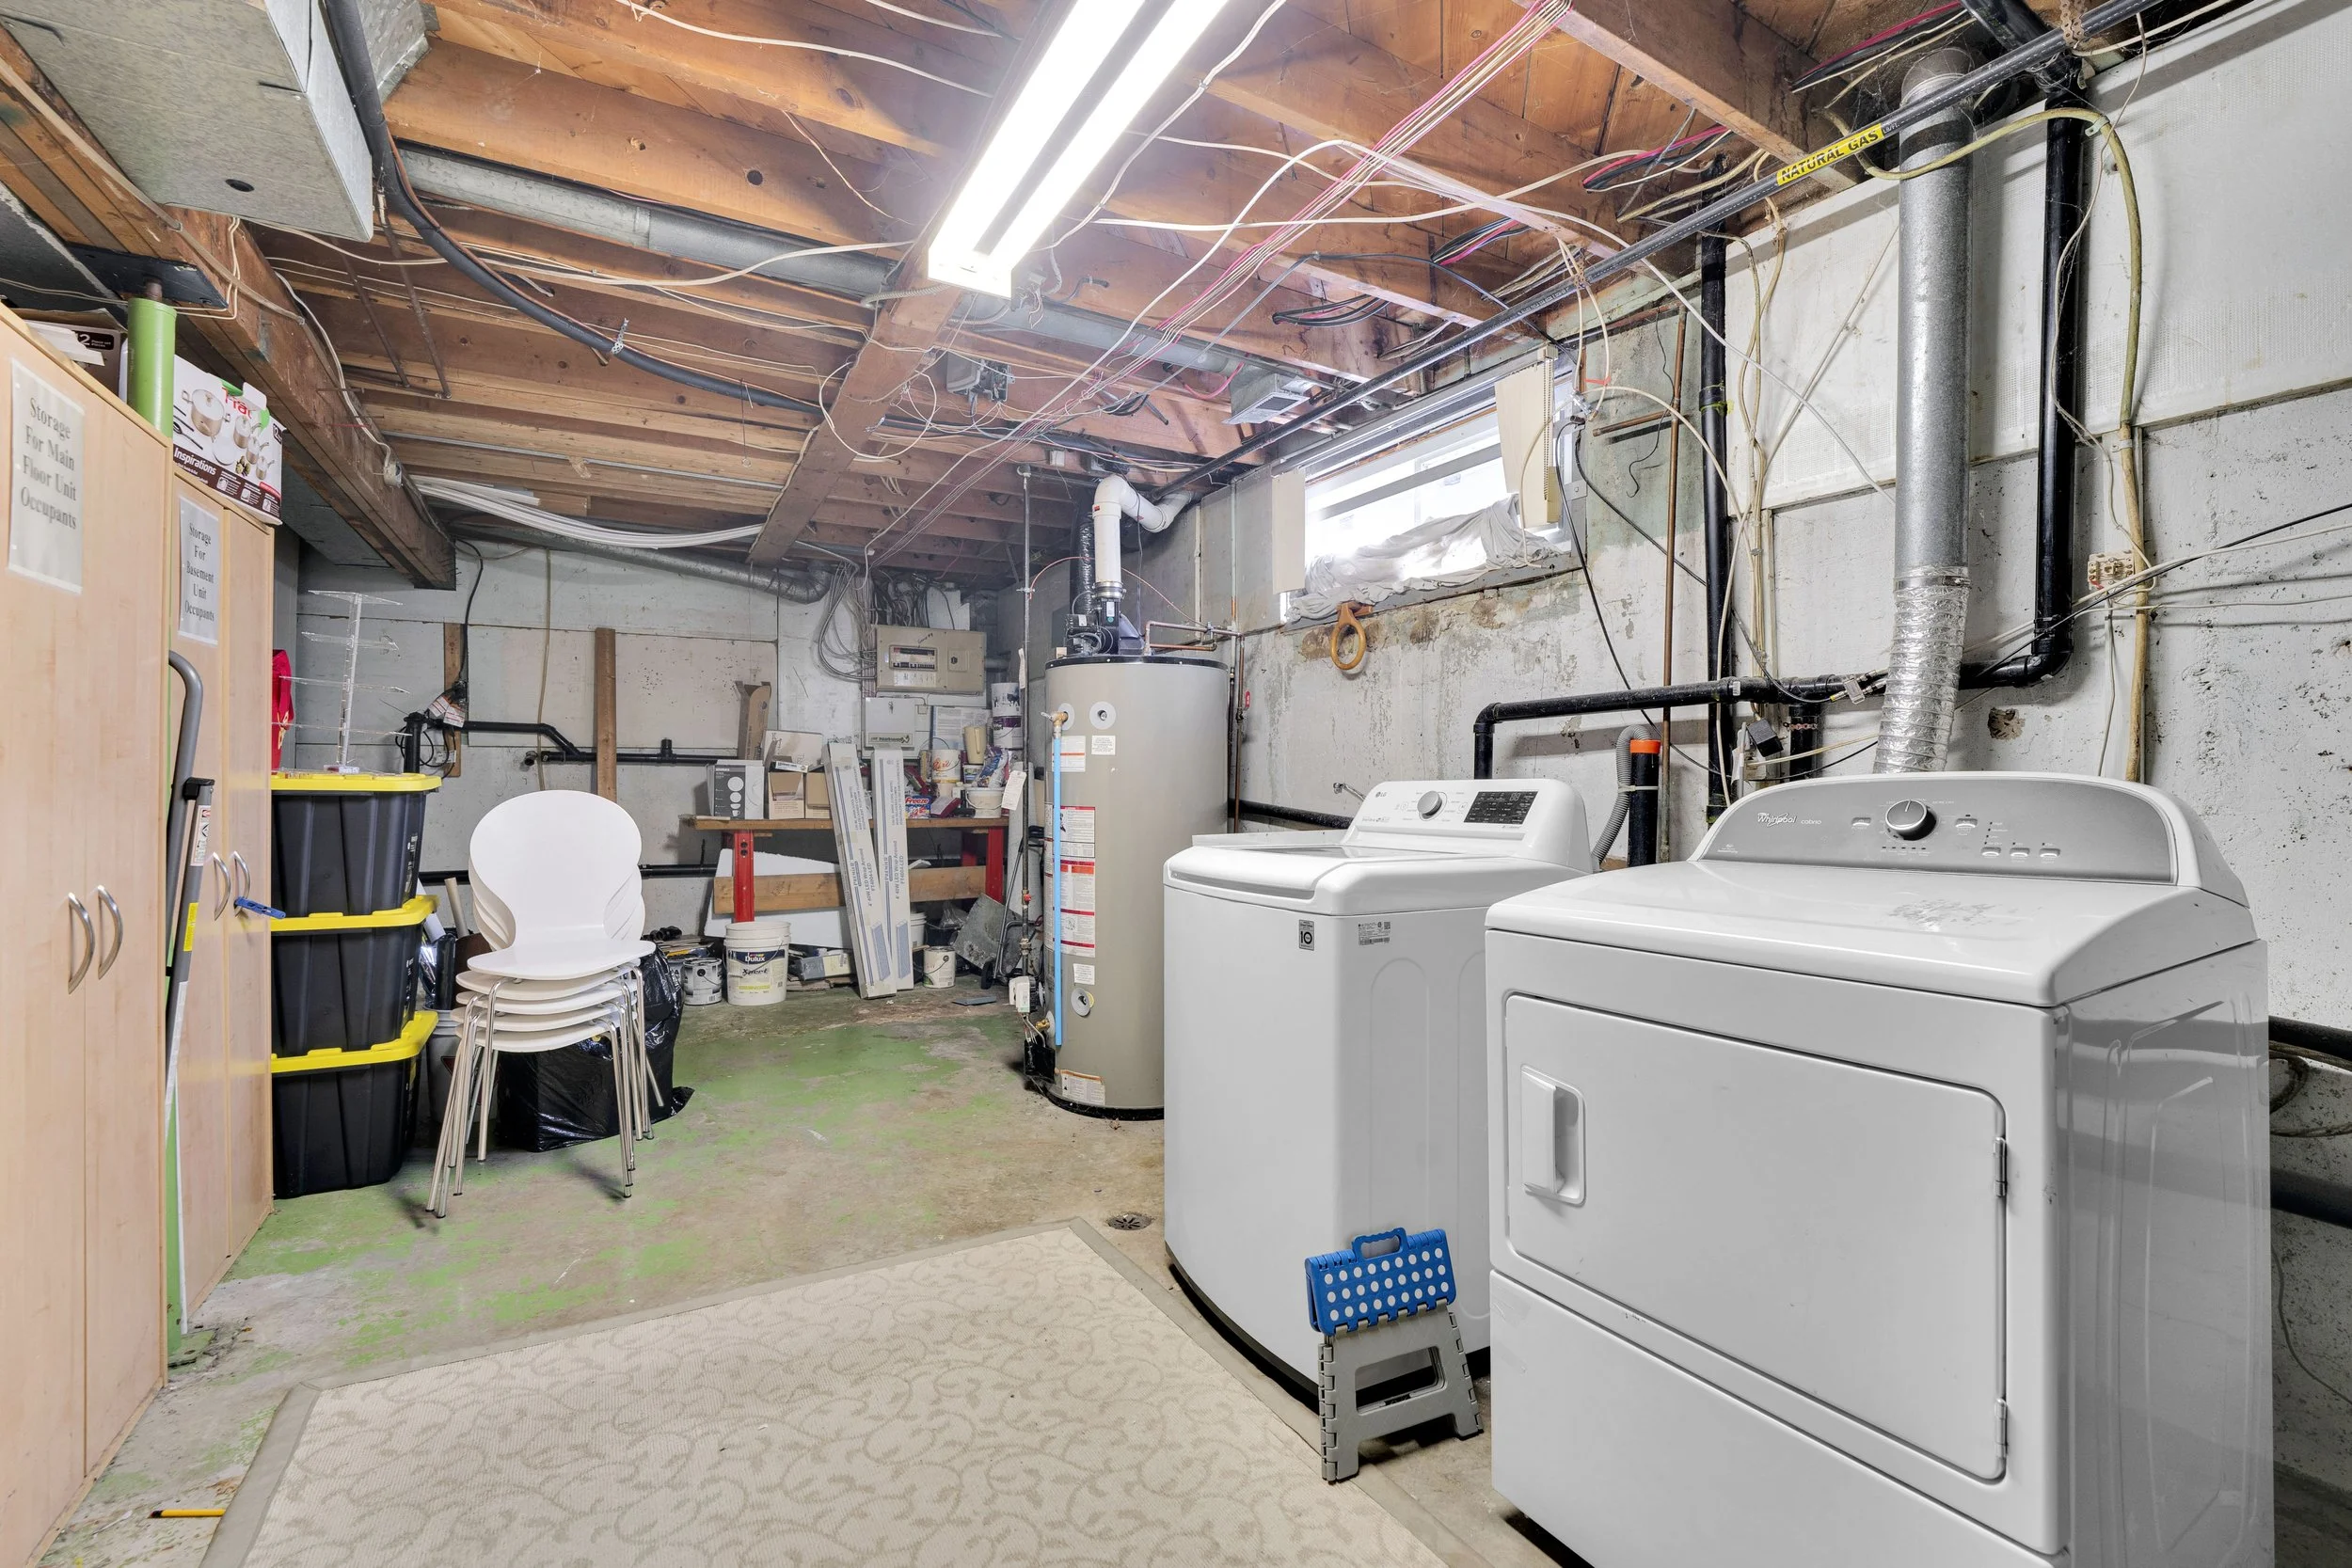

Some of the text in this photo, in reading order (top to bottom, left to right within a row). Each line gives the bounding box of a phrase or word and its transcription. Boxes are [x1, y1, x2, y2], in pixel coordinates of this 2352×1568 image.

[1781, 130, 1879, 182] NATURAL GAS
[30, 397, 72, 441] Storage
[25, 425, 75, 471] For Main
[174, 447, 216, 476] Inspirations
[23, 454, 77, 501] Floor Unit
[21, 485, 77, 531] Occupants
[188, 521, 212, 546] Storage
[194, 545, 206, 561] For
[186, 561, 215, 584] Basement
[193, 583, 207, 600] Unit
[185, 600, 215, 622] Occupants
[905, 796, 930, 804] Freeze
[1757, 812, 1797, 828] Whirlpool
